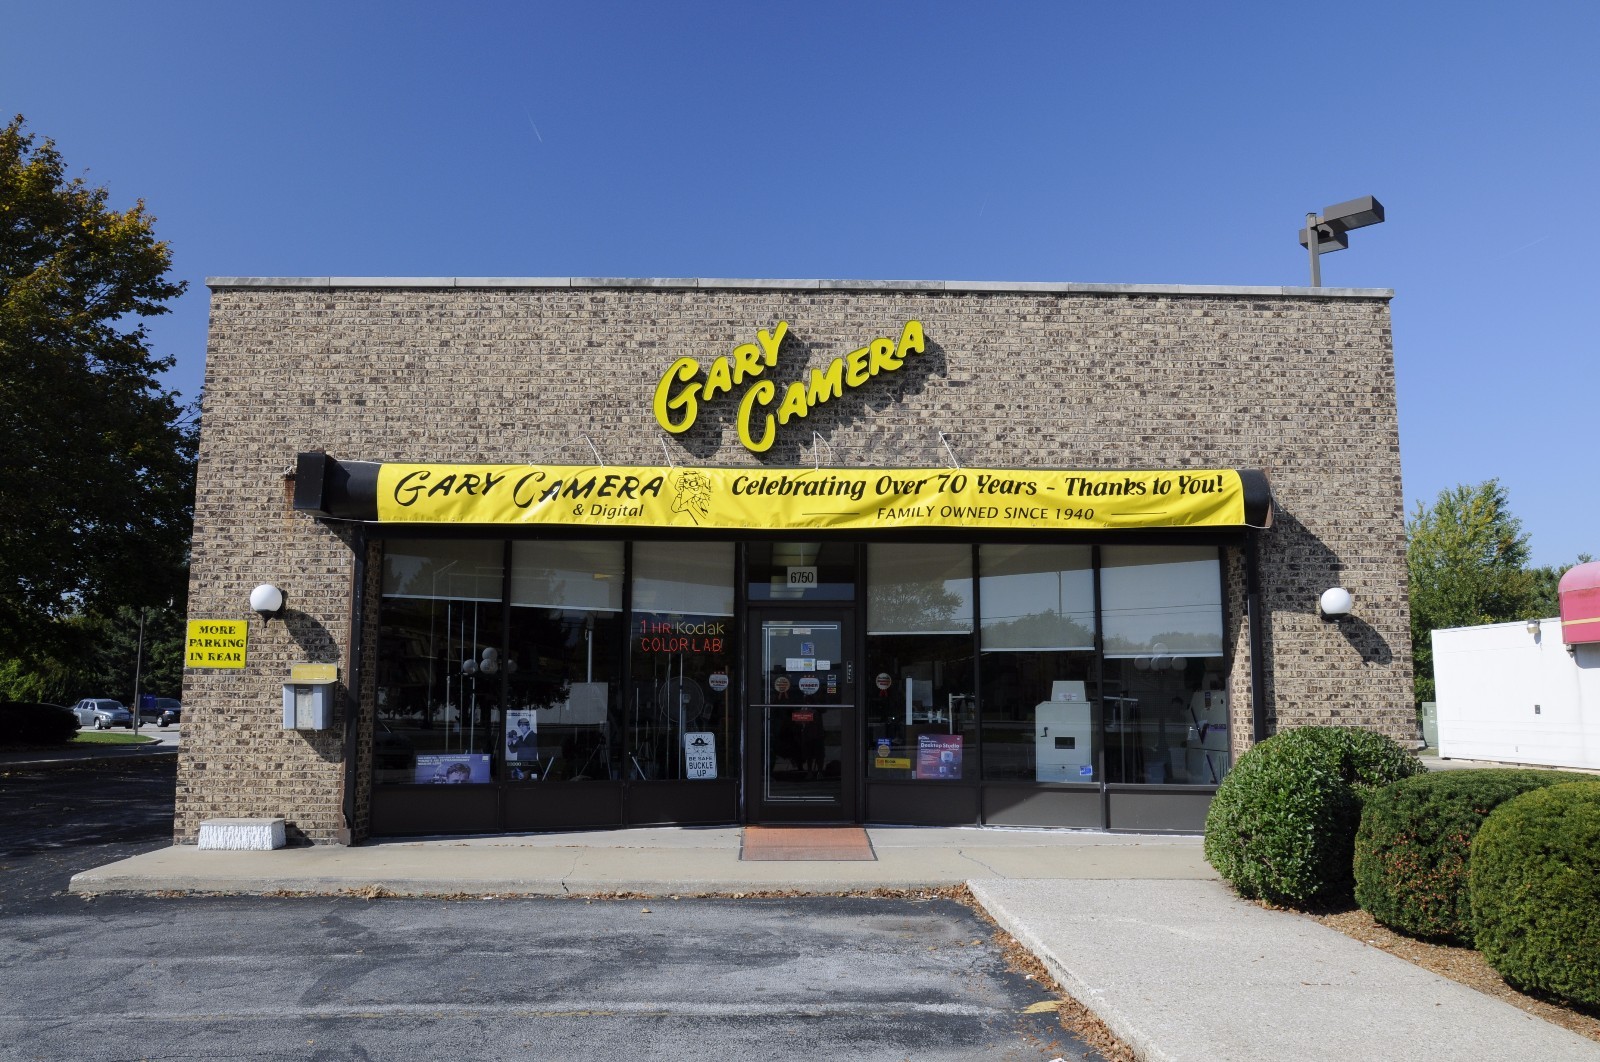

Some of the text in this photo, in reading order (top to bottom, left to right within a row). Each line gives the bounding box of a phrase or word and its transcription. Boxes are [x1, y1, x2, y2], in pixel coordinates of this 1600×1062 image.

[653, 320, 789, 434] GARY
[737, 319, 925, 452] CAMERA
[394, 470, 664, 509] GARY CAMERA
[731, 475, 867, 501] Celebrating
[875, 475, 928, 496] Over
[937, 474, 968, 494] 70
[977, 474, 1037, 496] Years
[1064, 476, 1147, 497] Thanks
[1152, 478, 1172, 495] to
[1178, 474, 1224, 495] You!
[572, 503, 644, 518] & Digital
[876, 505, 1095, 521] FAMILY OWNED SINCE 1940
[790, 571, 814, 584] 6750
[199, 625, 235, 635] MORE
[651, 622, 672, 635] HR
[676, 621, 725, 635] Kodak
[189, 638, 244, 648] PARKING
[641, 637, 721, 652] COLOR LAB
[190, 652, 241, 662] IN REAR
[689, 761, 713, 770] BUCKLE
[697, 769, 707, 777] UP
